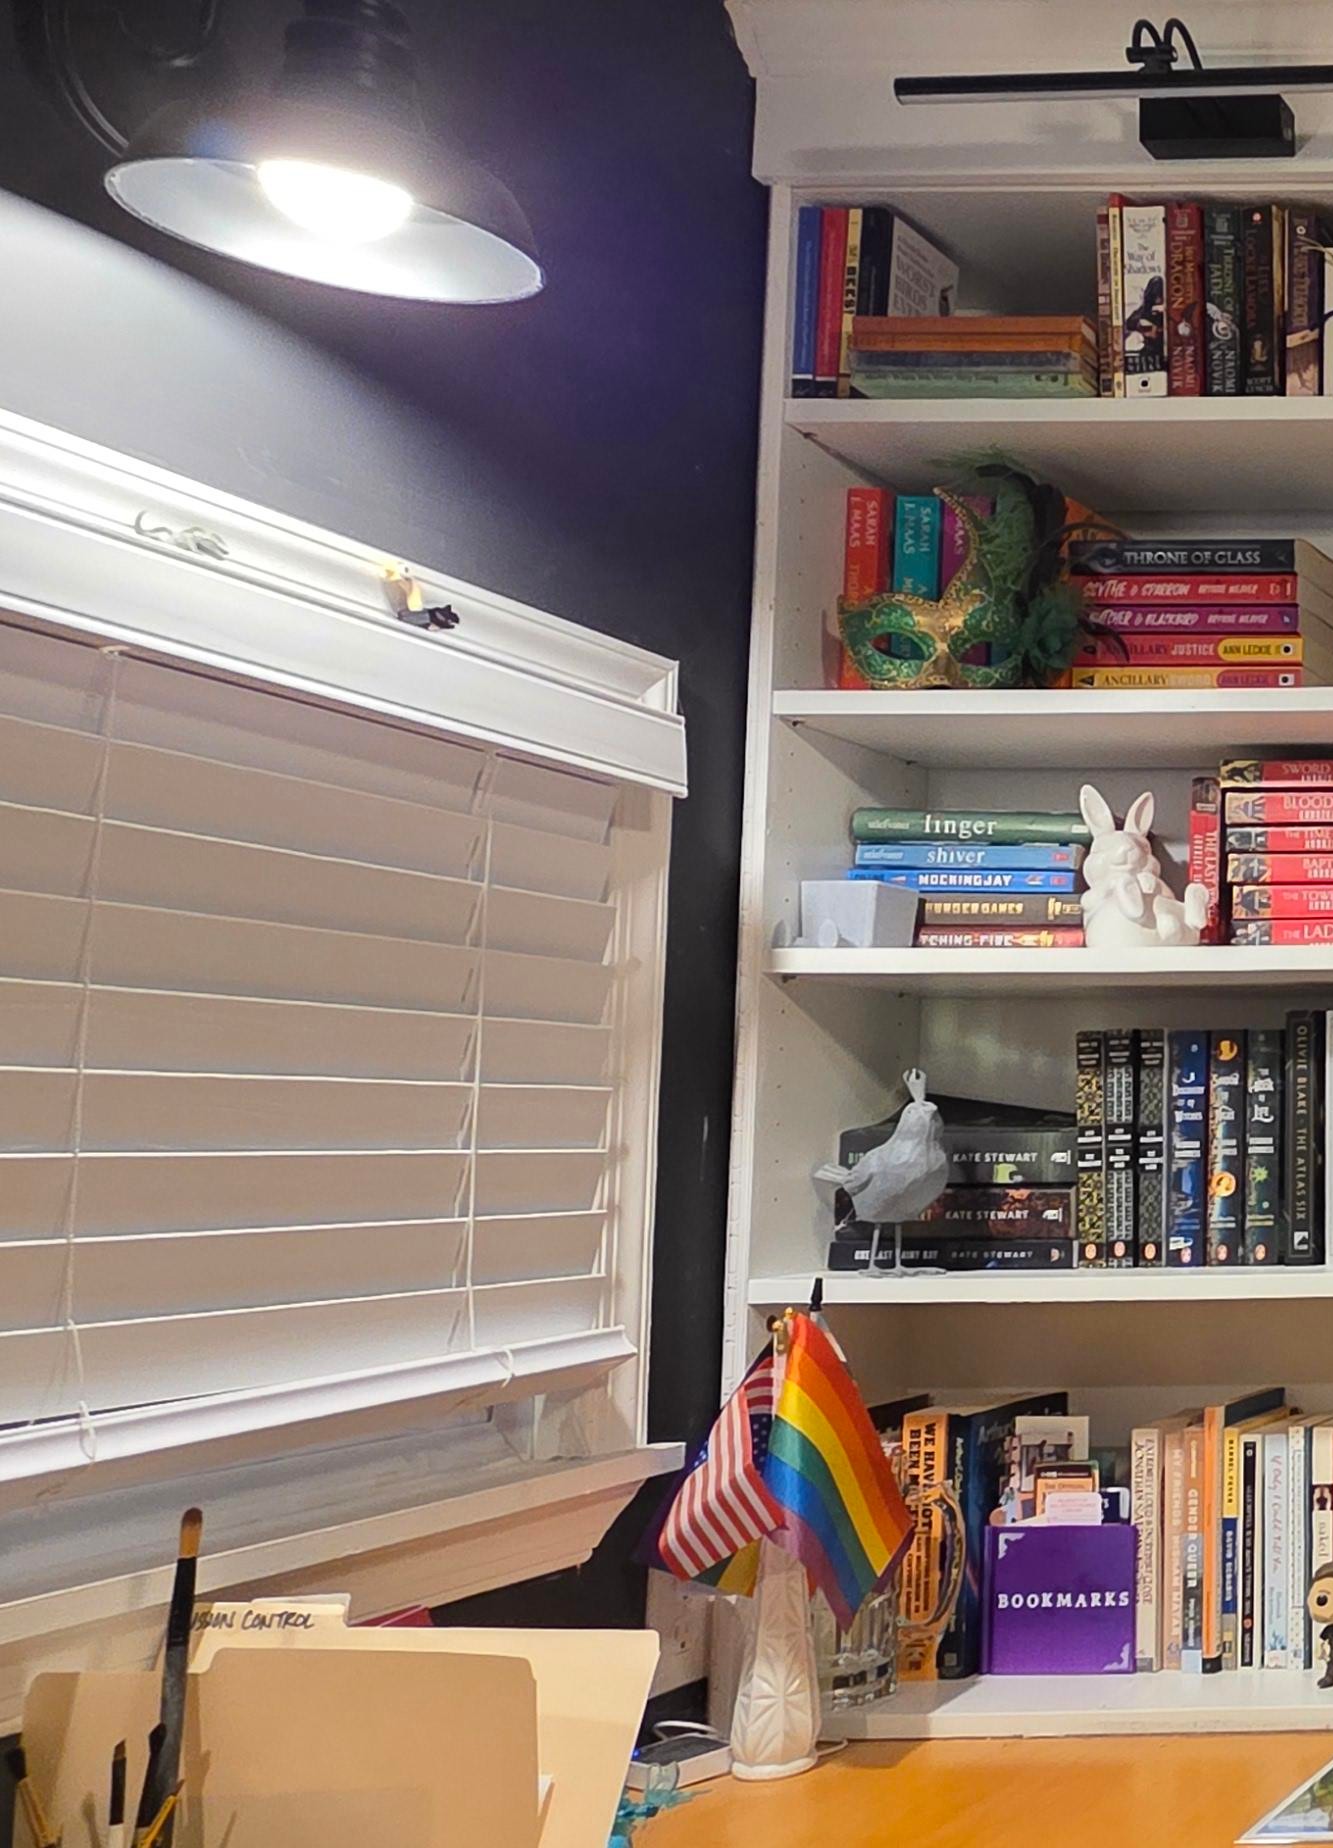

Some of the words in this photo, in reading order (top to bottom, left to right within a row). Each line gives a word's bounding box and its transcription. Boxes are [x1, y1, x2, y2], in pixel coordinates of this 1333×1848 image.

[865, 500, 877, 544] SARAH
[921, 508, 930, 551] SARAH
[1124, 551, 1188, 564] THRONE
[1193, 551, 1212, 564] OF
[1215, 551, 1260, 564] GLASS
[1104, 674, 1166, 685] ANCILLARY
[1282, 763, 1330, 774] SWORD
[1284, 797, 1333, 810] BLOOD
[922, 815, 997, 838] linger
[927, 848, 984, 866] shiver
[918, 874, 1012, 886] MOCKINGJAY
[1296, 1025, 1307, 1070] OLIVIE
[1297, 1077, 1307, 1114] BLAKE
[1297, 1128, 1307, 1151] THE
[953, 1153, 980, 1162] KATE
[984, 1153, 1037, 1162] STEWART
[1296, 1157, 1306, 1196] ATLAS
[1297, 1201, 1307, 1219] SIX
[909, 1429, 920, 1471] BEEN
[1188, 1489, 1198, 1539] GENDER
[1187, 1544, 1197, 1588] QUEER
[998, 1592, 1129, 1608] BOOKMARKS
[242, 1610, 314, 1630] CONTROL
